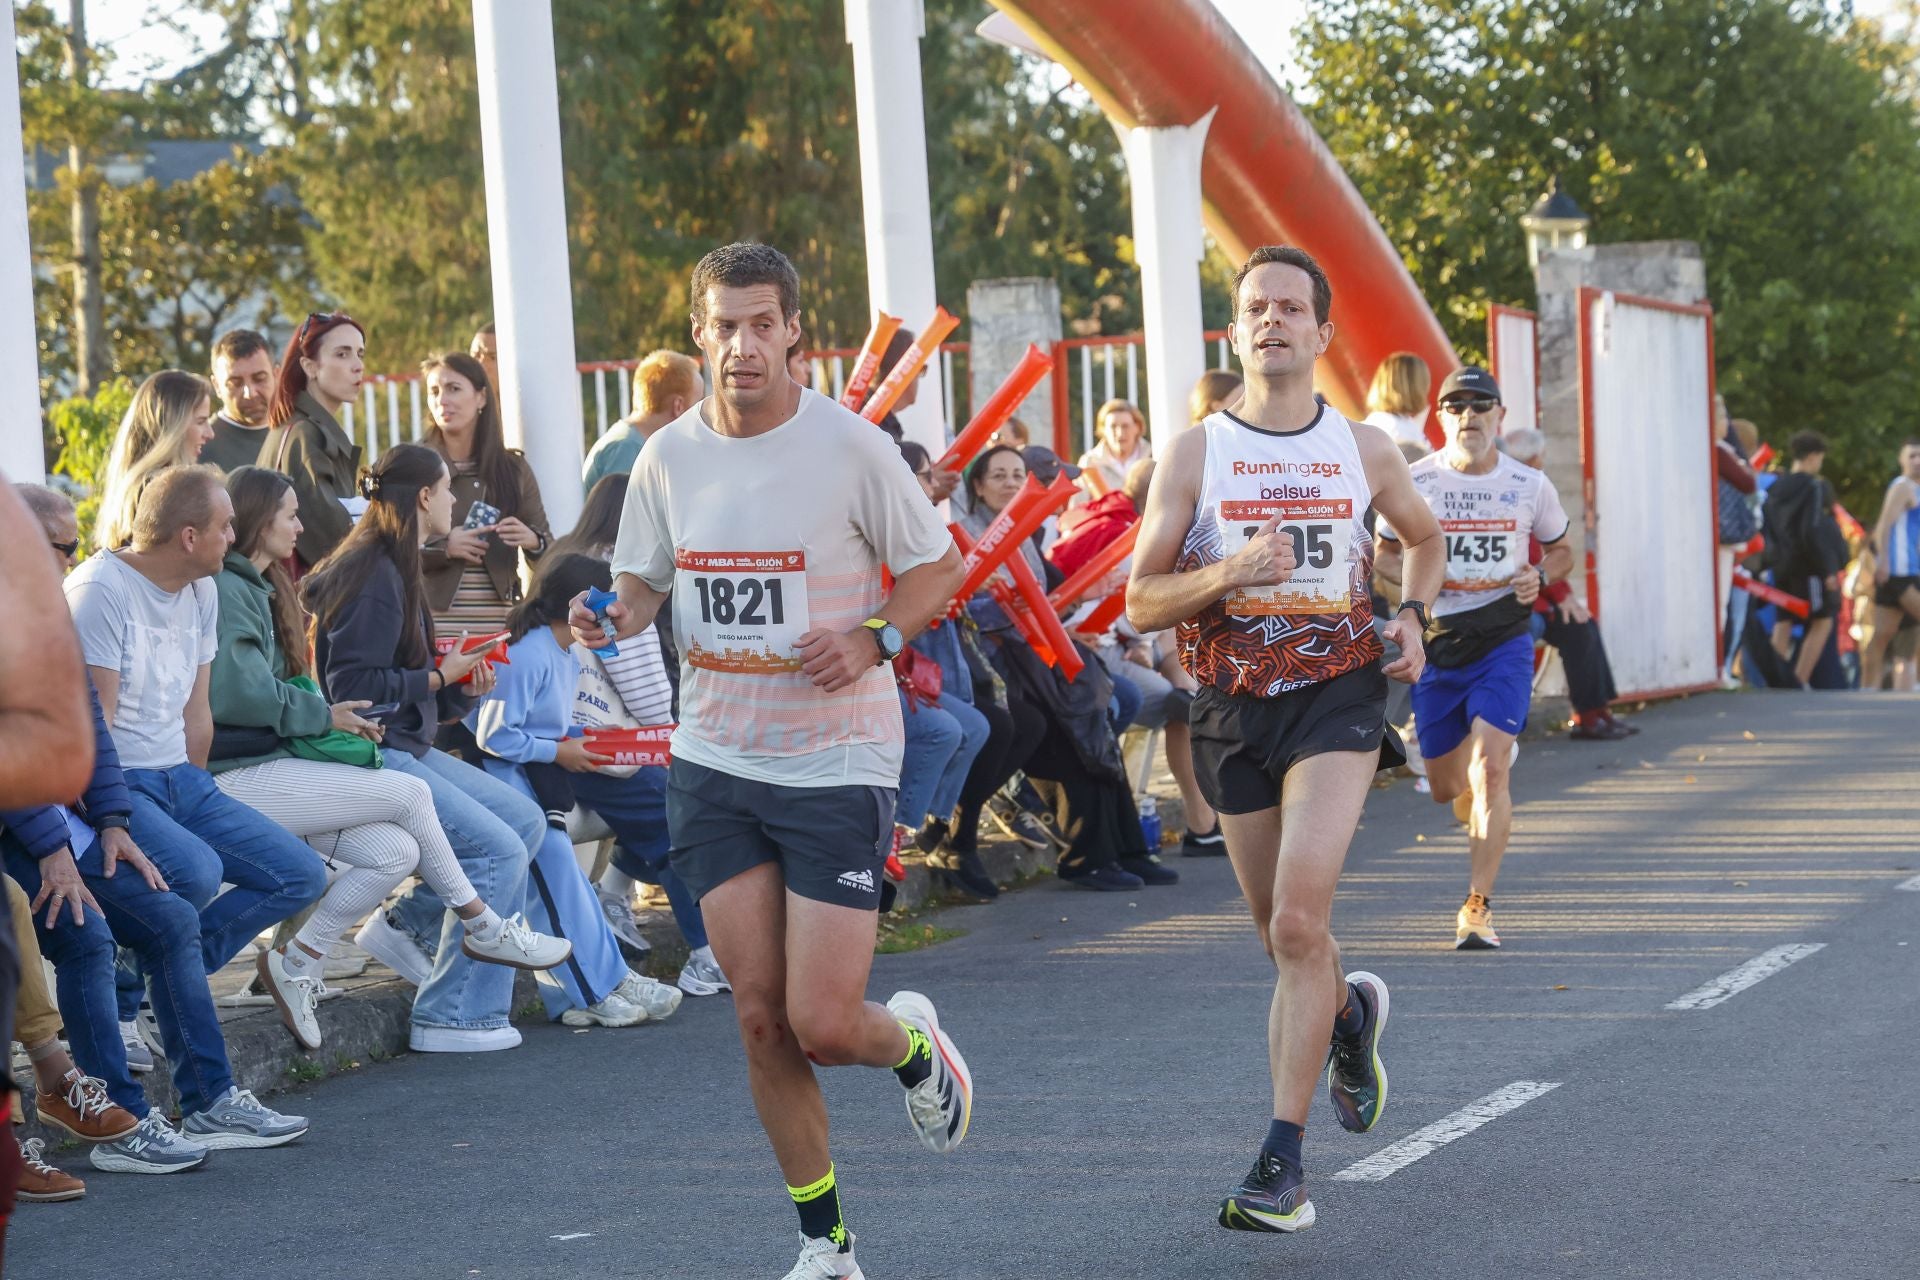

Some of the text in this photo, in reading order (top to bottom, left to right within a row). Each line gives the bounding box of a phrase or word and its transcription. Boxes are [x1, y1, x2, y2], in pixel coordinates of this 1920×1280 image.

[1233, 458, 1342, 478] Runningzgz
[1462, 491, 1492, 501] RETO
[1307, 504, 1334, 514] GIJÓN
[1444, 501, 1477, 511] VIAJE
[1243, 524, 1333, 569] 05
[1445, 535, 1507, 563] 1435
[707, 558, 735, 567] MBA
[756, 556, 783, 567] GIJÓN
[694, 577, 784, 625] 1821
[717, 633, 736, 641] DIEGO
[636, 728, 672, 742] MB
[614, 751, 667, 765] MBA
[837, 878, 858, 888] NIKE
